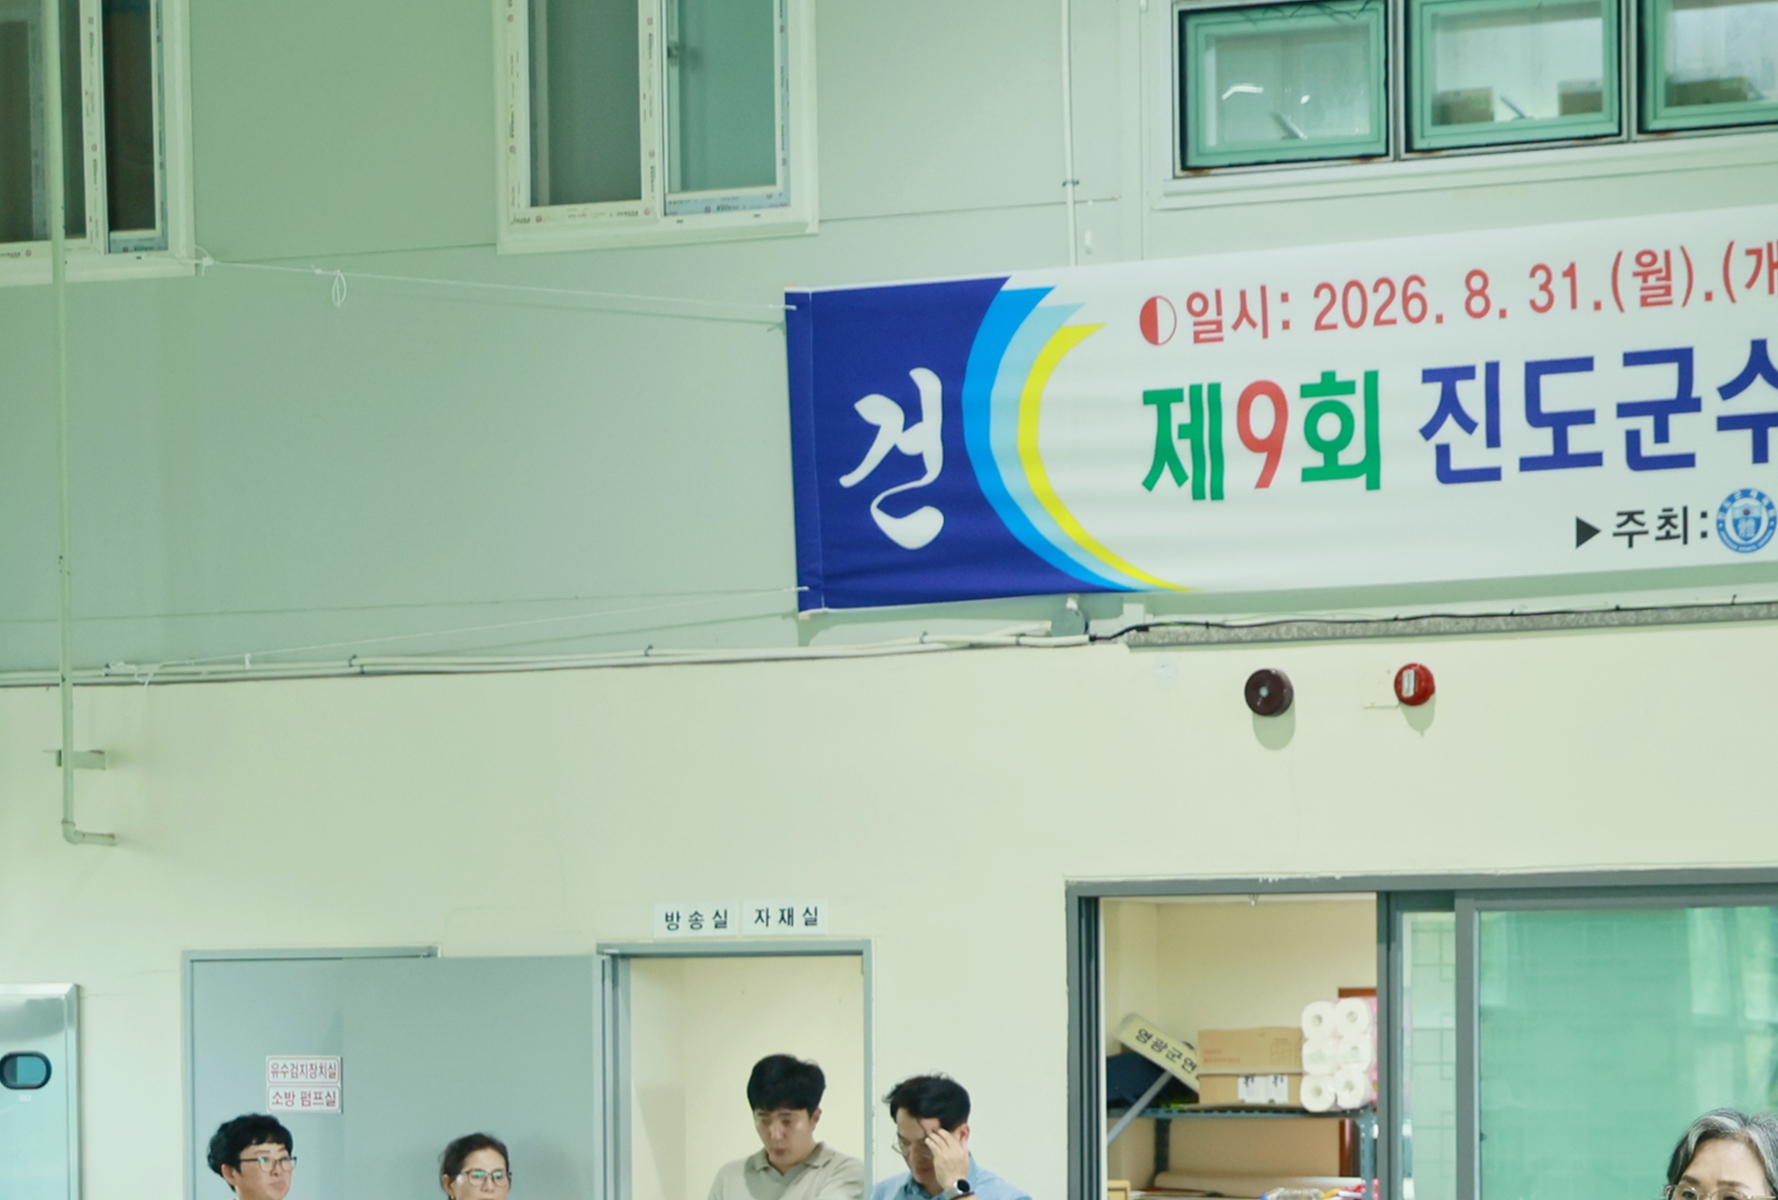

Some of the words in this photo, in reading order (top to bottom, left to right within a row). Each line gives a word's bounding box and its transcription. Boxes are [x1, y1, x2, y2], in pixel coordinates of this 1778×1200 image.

[1186, 285, 1290, 344] 일시:
[1314, 275, 1443, 331] 2026.
[1465, 269, 1506, 319] 8.
[1142, 370, 1381, 501] 제9회
[1613, 506, 1707, 548] 주최:
[665, 910, 727, 930] 방송실
[755, 907, 817, 927] 자재실
[271, 1063, 336, 1079] 유수검지장치실
[1135, 1027, 1199, 1080] 영광군연
